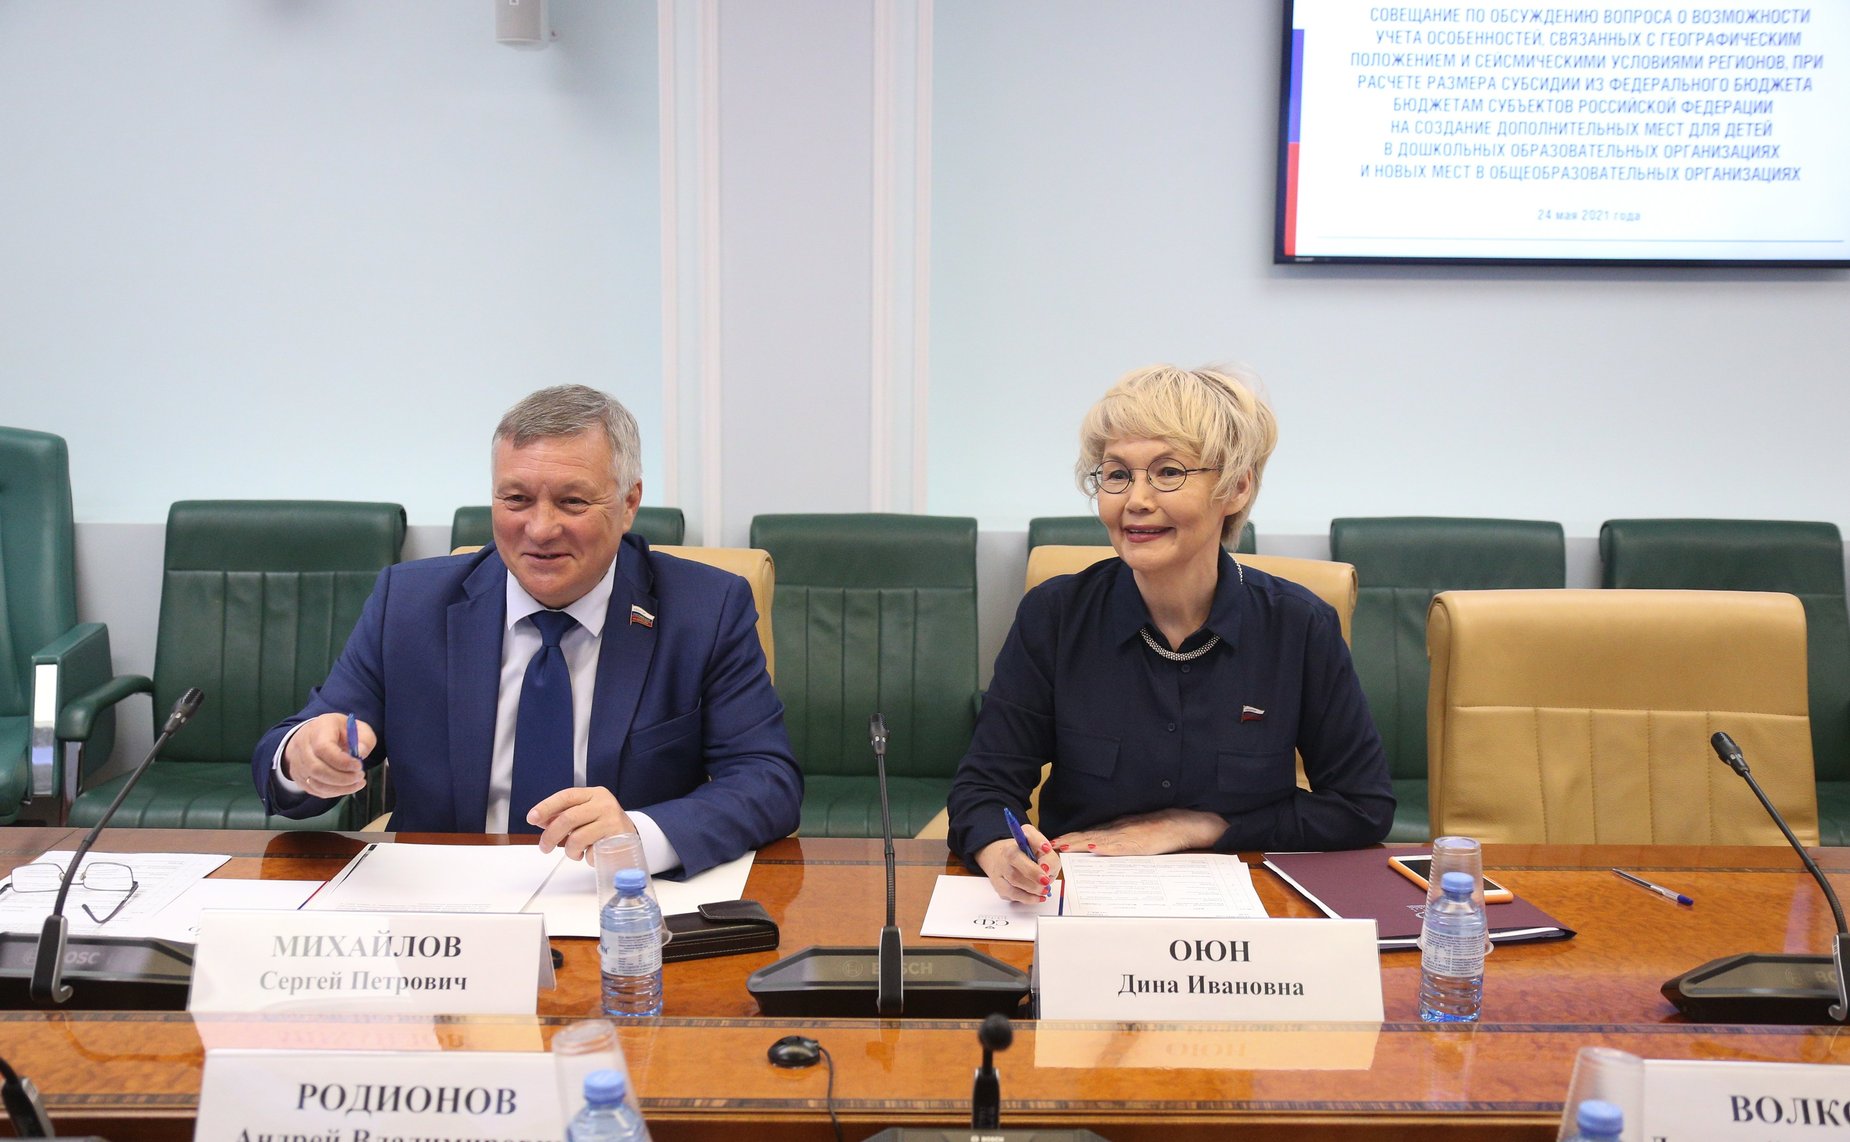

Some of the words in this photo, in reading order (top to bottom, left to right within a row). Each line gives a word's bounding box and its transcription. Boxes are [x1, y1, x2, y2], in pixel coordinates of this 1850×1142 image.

[1370, 7, 1461, 24] СОВЕЩАНИЕ
[1465, 8, 1486, 23] ПО
[1490, 8, 1599, 25] ОБСУЖДЕНИЮ
[1603, 9, 1673, 24] ВОПРОСА
[1677, 9, 1688, 24] О
[1691, 9, 1811, 24] ВОЗМОЖНОСТИ
[1376, 30, 1422, 44] УЧЕТА
[1549, 31, 1641, 46] СВЯЗАННЫХ
[1646, 32, 1656, 46] С
[1660, 31, 1802, 47] ГЕОГРАФИЧЕСКИМ
[1350, 52, 1456, 67] ПОЛОЖЕНИЕМ
[1461, 54, 1470, 67] И
[1475, 52, 1606, 69] СЕЙСМИЧЕСКИМИ
[1611, 55, 1704, 69] УСЛОВИЯМИ
[1793, 55, 1824, 69] ПРИ
[1357, 75, 1422, 89] РАСЧЕТЕ
[1427, 76, 1497, 90] РАЗМЕРА
[1501, 76, 1581, 93] СУБСИДИИ
[1586, 77, 1604, 92] ИЗ
[1609, 77, 1729, 94] ФЕДЕРАЛЬНОГО
[1733, 77, 1813, 94] БЮДЖЕТА
[1393, 97, 1483, 113] БЮДЖЕТАМ
[1488, 98, 1573, 113] СУБЪЕКТОВ
[1578, 97, 1676, 114] РОССИЙСКОЙ
[1681, 99, 1774, 115] ФЕДЕРАЦИИ
[1390, 120, 1410, 134] НА
[1414, 120, 1492, 136] СОЗДАНИЕ
[1496, 121, 1639, 137] ДОПОЛНИТЕЛЬНЫХ
[1644, 122, 1684, 136] МЕСТ
[1688, 122, 1720, 138] ДЛЯ
[1724, 120, 1773, 138] ДЕТЕЙ
[1384, 142, 1393, 156] В
[1398, 142, 1506, 158] ДОШКОЛЬНЫХ
[1510, 143, 1659, 158] ОБРАЗОВАТЕЛЬНЫХ
[1663, 144, 1781, 160] ОРГАНИЗАЦИЯХ
[1360, 164, 1370, 177] И
[1375, 164, 1427, 178] НОВЫХ
[1431, 165, 1470, 179] МЕСТ
[1476, 165, 1485, 179] В
[1489, 165, 1680, 181] ОБЩЕОБРАЗОВАТЕЛЬНЫХ
[1684, 167, 1802, 183] ОРГАНИЗАЦИЯХ
[1537, 209, 1552, 220] 24
[1556, 211, 1578, 220] мая
[1582, 209, 1609, 221] 2021
[1613, 211, 1641, 222] года
[271, 930, 462, 958] МИХАЙЛОВ
[1169, 939, 1252, 963] ОЮН
[259, 970, 342, 996] Сергей
[350, 971, 468, 996] Петрович
[1118, 974, 1179, 997] Дина
[1187, 975, 1305, 996] Ивановна
[296, 1082, 518, 1117] РОДИОНОВ
[1729, 1095, 1850, 1127] ВОЛК
